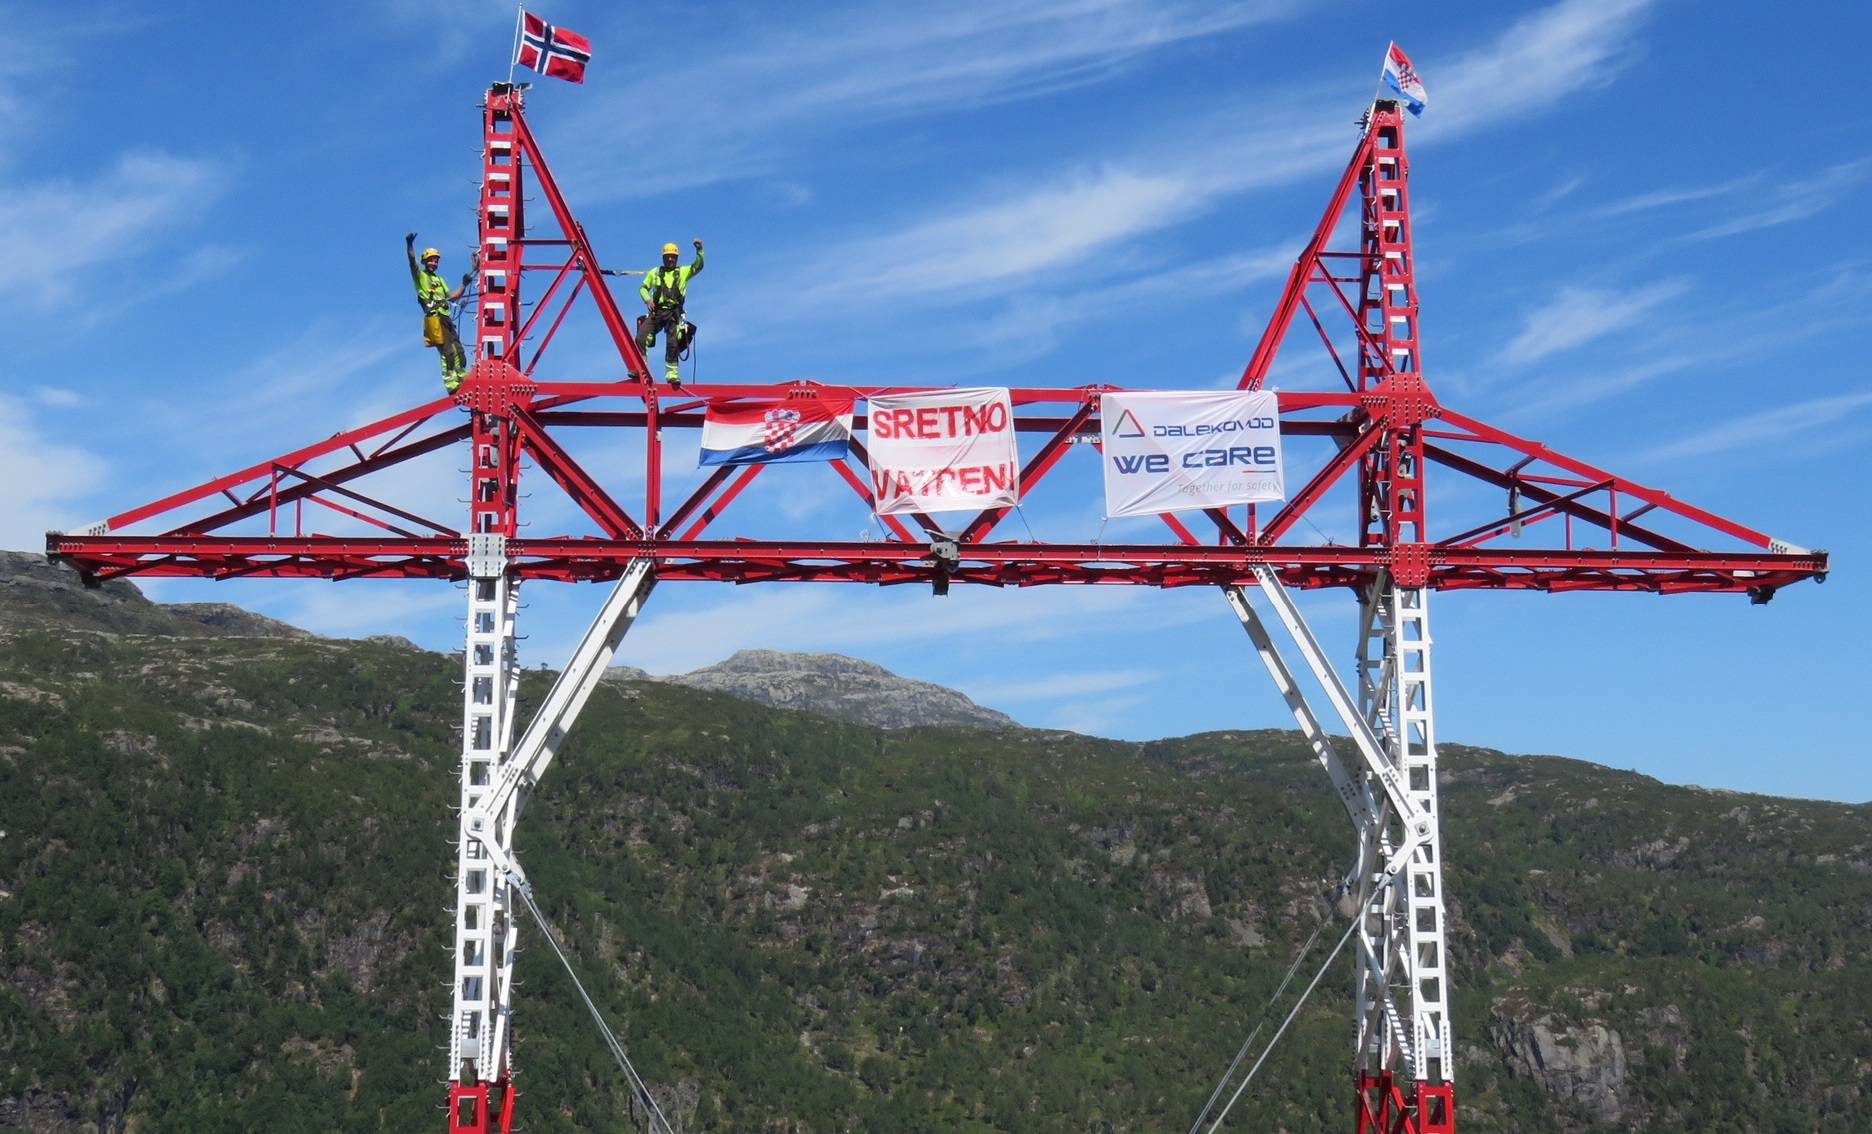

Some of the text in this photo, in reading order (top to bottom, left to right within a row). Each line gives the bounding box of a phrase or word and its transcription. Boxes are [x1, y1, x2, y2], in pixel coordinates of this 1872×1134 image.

[873, 402, 1007, 439] SRETNO
[1113, 446, 1276, 474] we care
[1177, 481, 1225, 496] Together
[1226, 480, 1243, 494] for
